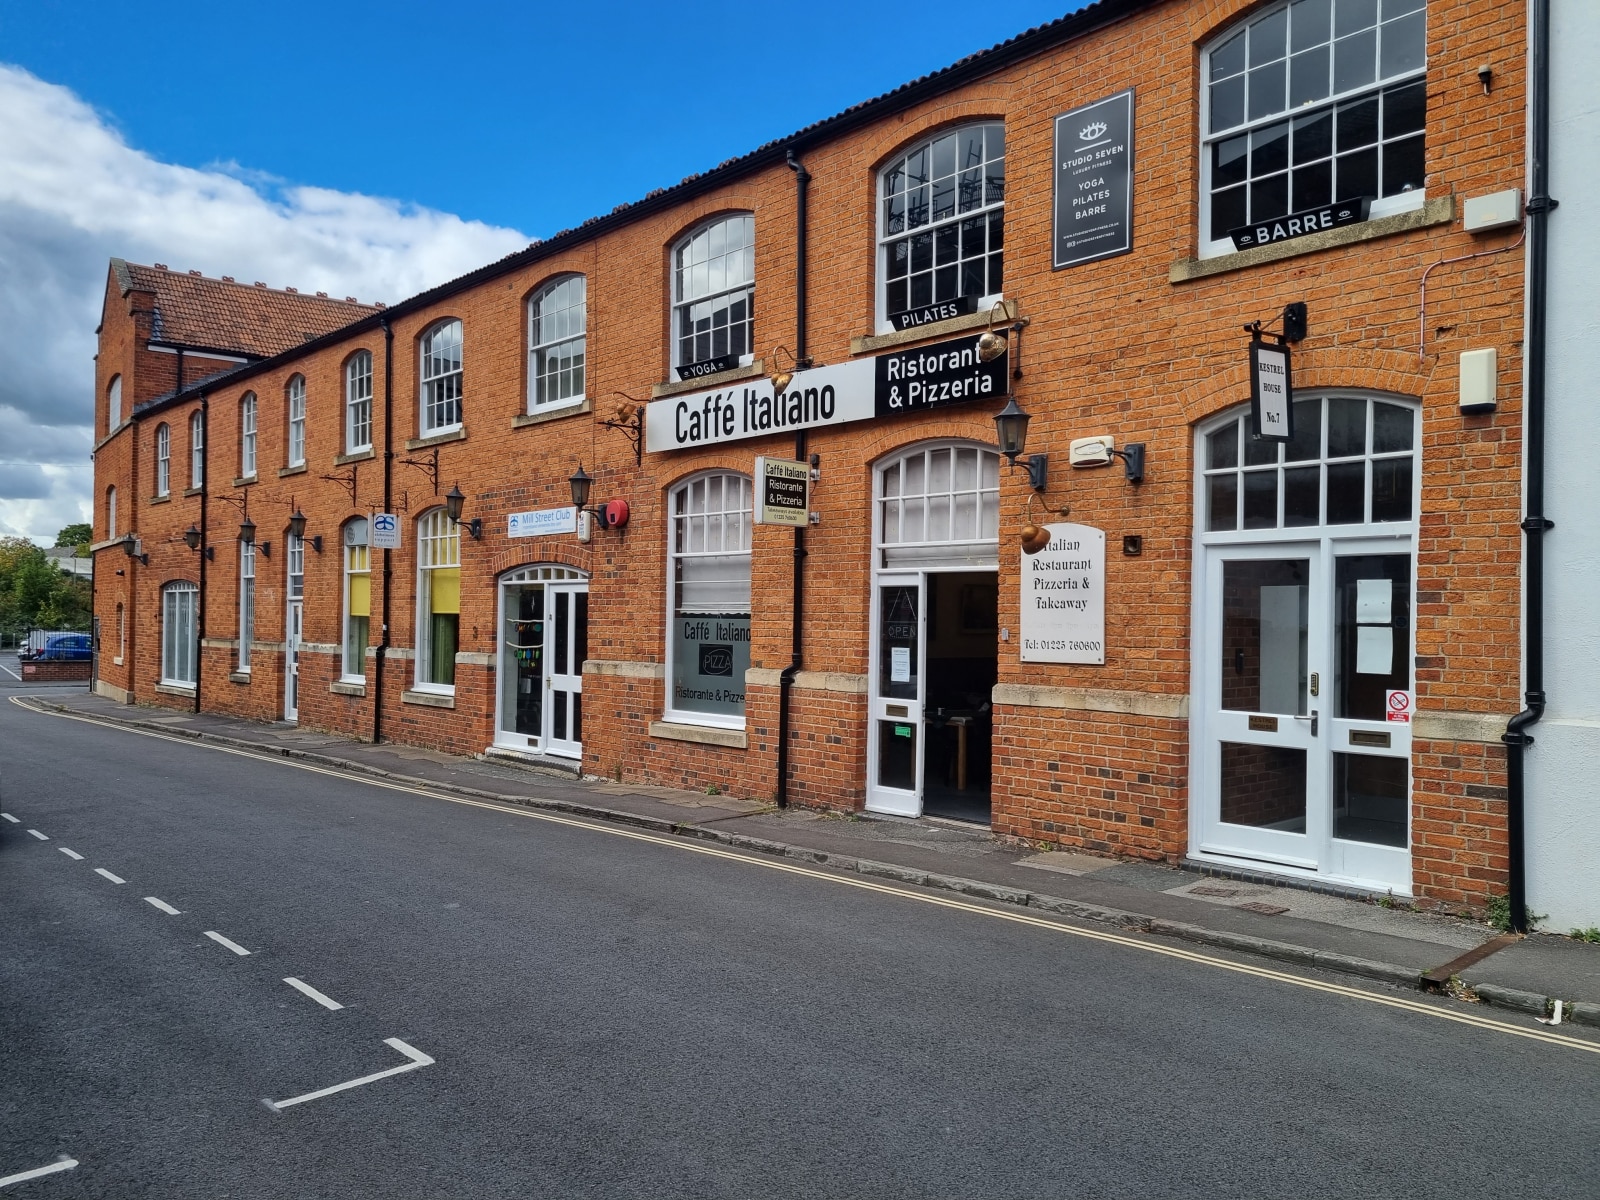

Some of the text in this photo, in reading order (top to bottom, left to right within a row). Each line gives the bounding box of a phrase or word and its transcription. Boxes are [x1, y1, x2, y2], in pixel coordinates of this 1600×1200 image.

[1062, 144, 1124, 170] STUDIO SEVEN
[1078, 177, 1105, 191] YOGA
[1072, 189, 1110, 207] PILATES
[1075, 204, 1107, 220] BARRE
[1256, 209, 1334, 244] BARRE
[901, 303, 958, 328] PILATES
[690, 361, 717, 377] YOGA
[887, 342, 982, 381] Ristorant
[1258, 362, 1284, 375] KESTREL
[888, 370, 992, 408] & Pizzeria
[1263, 382, 1282, 394] HOUSE
[675, 384, 835, 444] Caffé Italiano
[1266, 411, 1280, 424] No.7
[766, 463, 807, 480] Caffé Italiano
[769, 479, 803, 493] Ristorante
[769, 493, 803, 506] & Pizzeria
[522, 509, 571, 524] Mill Street Club
[1032, 558, 1092, 572] Restaurant
[1033, 576, 1090, 590] Pizzeria &
[1035, 596, 1088, 612] Takeaway
[684, 621, 751, 642] Caffé Italiano
[888, 625, 916, 638] OPEN
[1024, 639, 1101, 651] Tel: 01225 760600
[704, 654, 732, 669] PIZZA
[675, 685, 745, 704] Ristorante & Pizze
